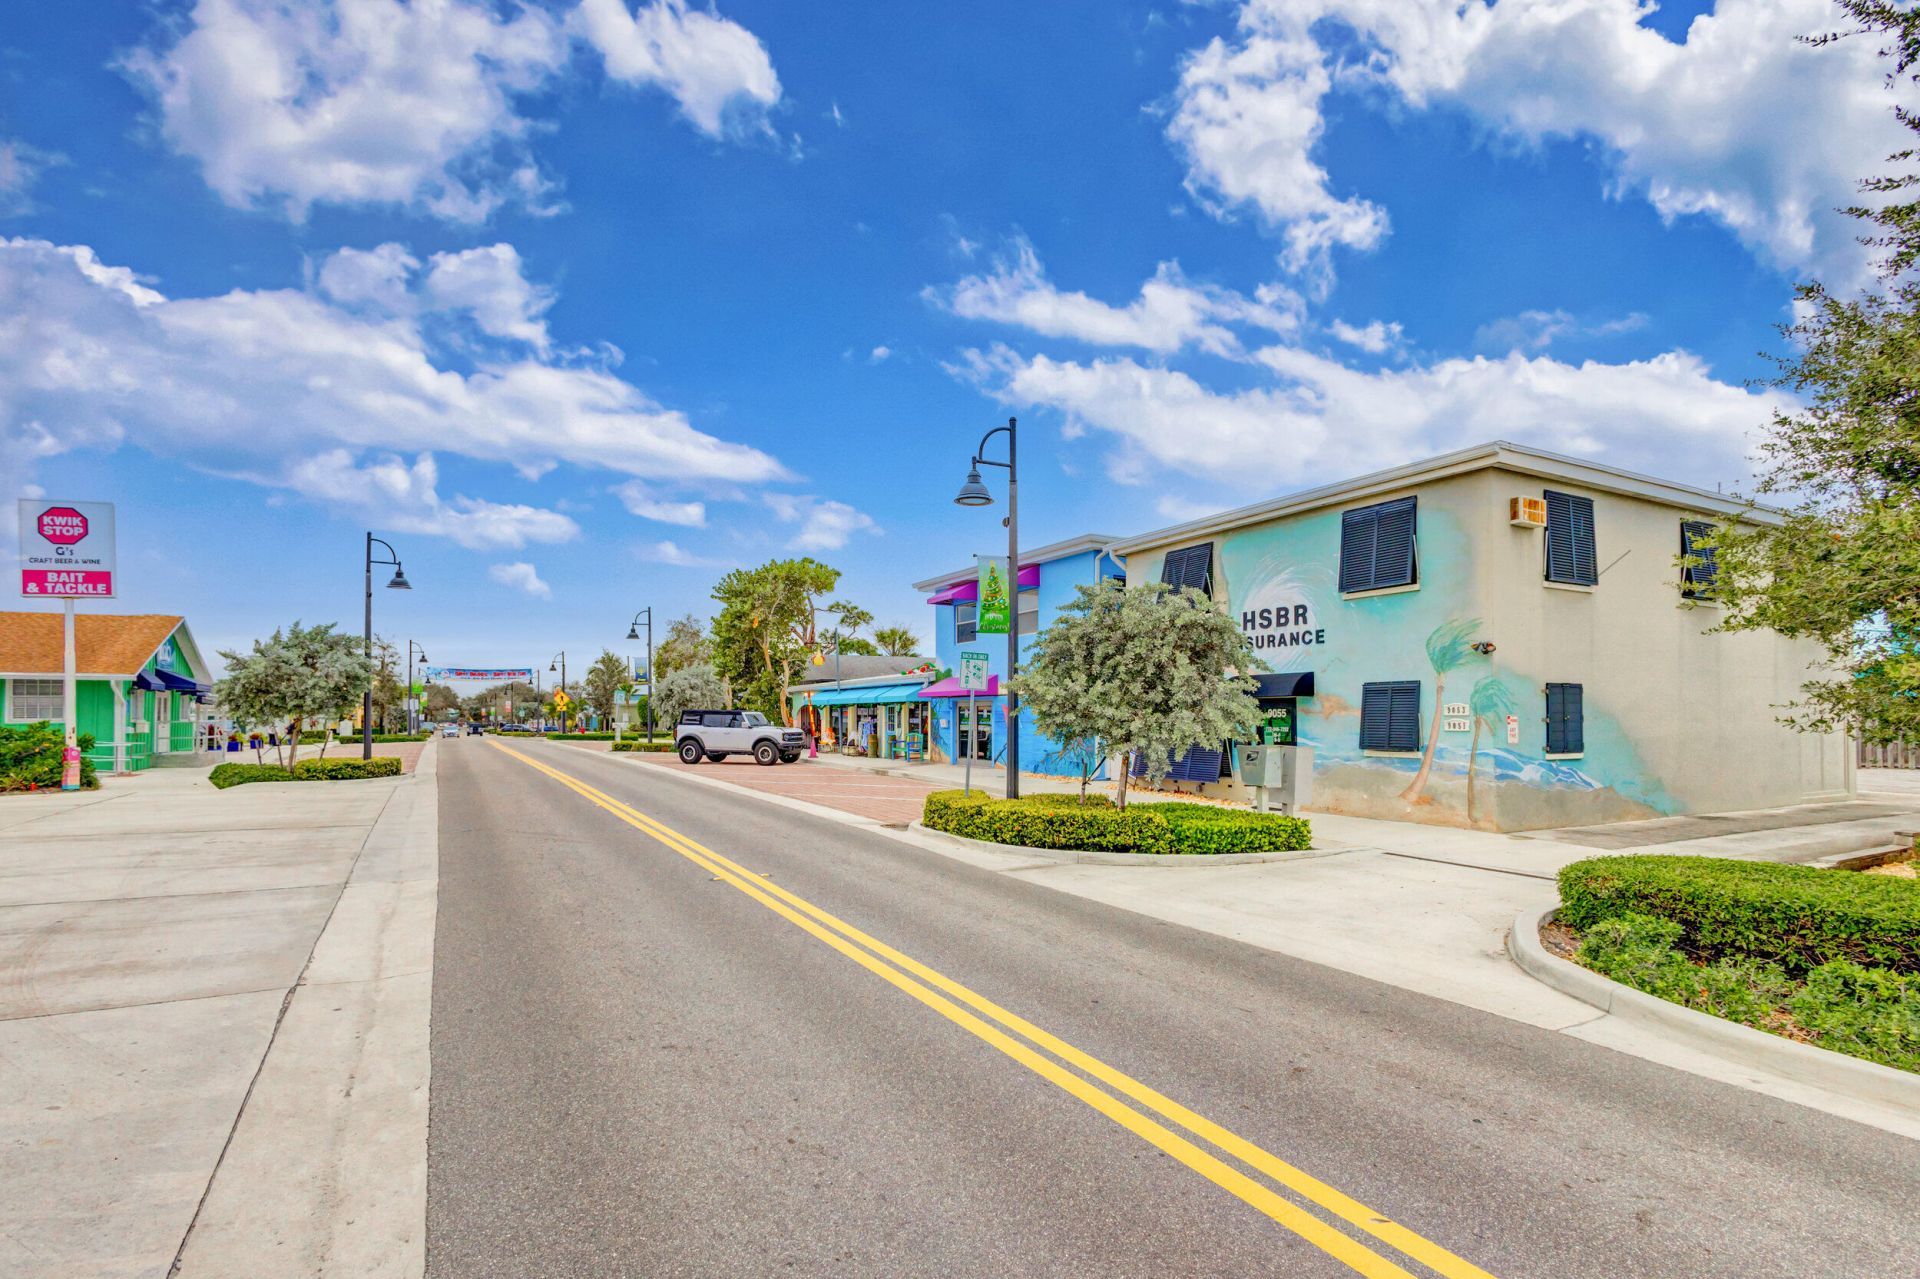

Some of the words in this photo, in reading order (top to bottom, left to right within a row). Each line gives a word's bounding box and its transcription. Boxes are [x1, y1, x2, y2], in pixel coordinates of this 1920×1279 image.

[43, 516, 83, 526] KWIK
[43, 526, 83, 535] STOP
[55, 546, 74, 556] G's
[47, 571, 86, 583] BAIT
[26, 582, 39, 593] &
[45, 583, 106, 593] TACKLE
[1242, 604, 1308, 631] HSBR
[1239, 629, 1325, 650] SURANCE
[1267, 708, 1287, 718] 9055
[1447, 706, 1466, 714] 9053
